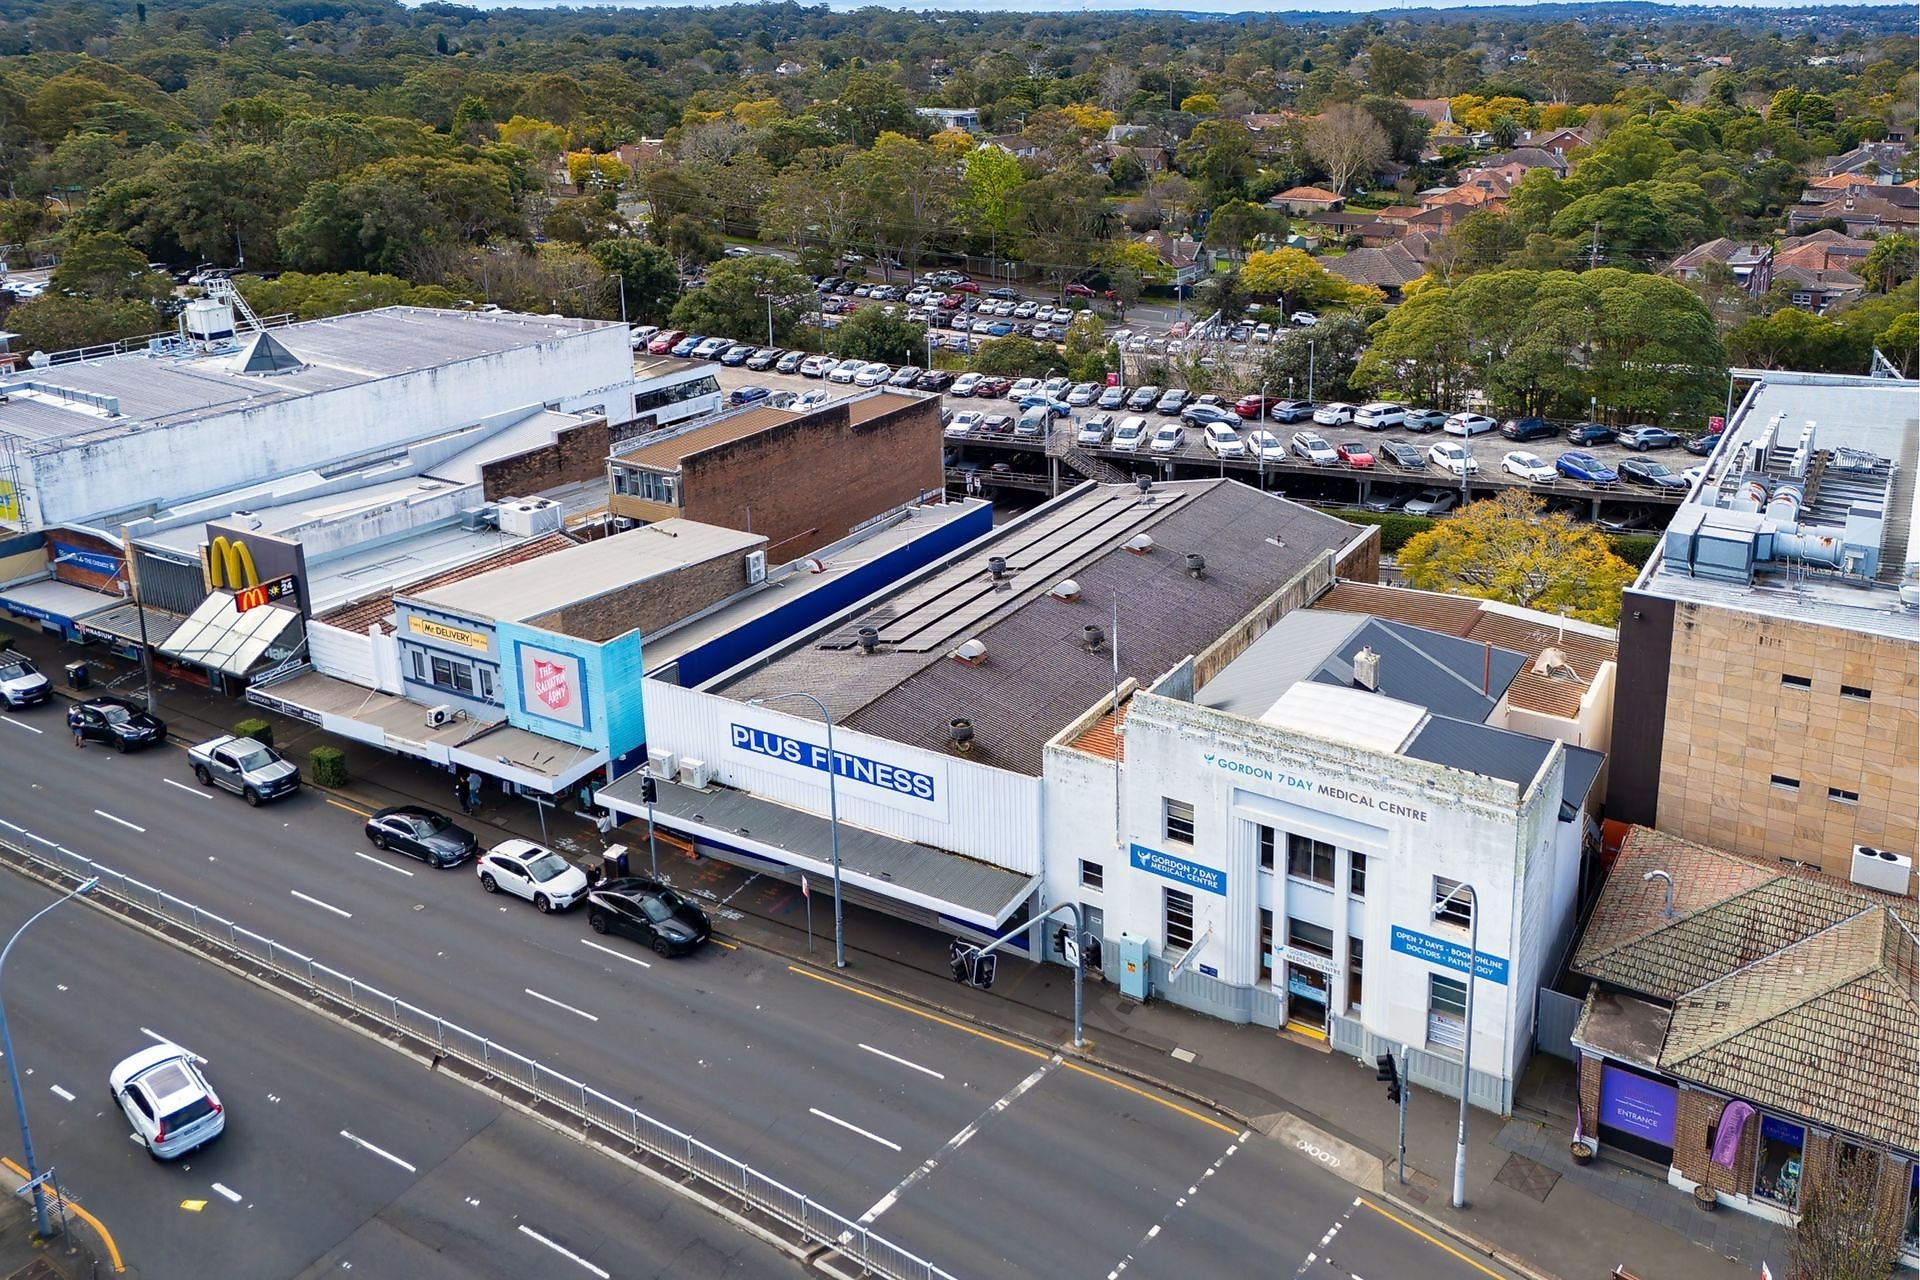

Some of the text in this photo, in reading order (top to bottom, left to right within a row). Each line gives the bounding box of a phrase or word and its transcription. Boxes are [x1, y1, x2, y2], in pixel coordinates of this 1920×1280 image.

[281, 581, 293, 592] 24
[436, 626, 470, 643] DELIVERY
[540, 663, 553, 678] THE
[536, 671, 567, 695] SALVATION
[549, 684, 566, 704] ARMY
[734, 727, 801, 763] PLUS
[1217, 758, 1428, 822] GORDON 7 DAY MEDICAL CENTRE
[1150, 863, 1218, 889] MEDICAL CENTRE
[1151, 854, 1218, 881] GORDON 7 DAY
[1289, 948, 1317, 962] GORDON
[1324, 960, 1338, 968] DAY
[1396, 931, 1503, 970] OPEN 7 DAYS BOOK ONLINE
[1406, 944, 1441, 959] DOCTORS
[1286, 953, 1341, 976] MEDICAL CENTRE
[1617, 1108, 1658, 1127] ENTRANCE
[1299, 1141, 1338, 1167] LOOK
